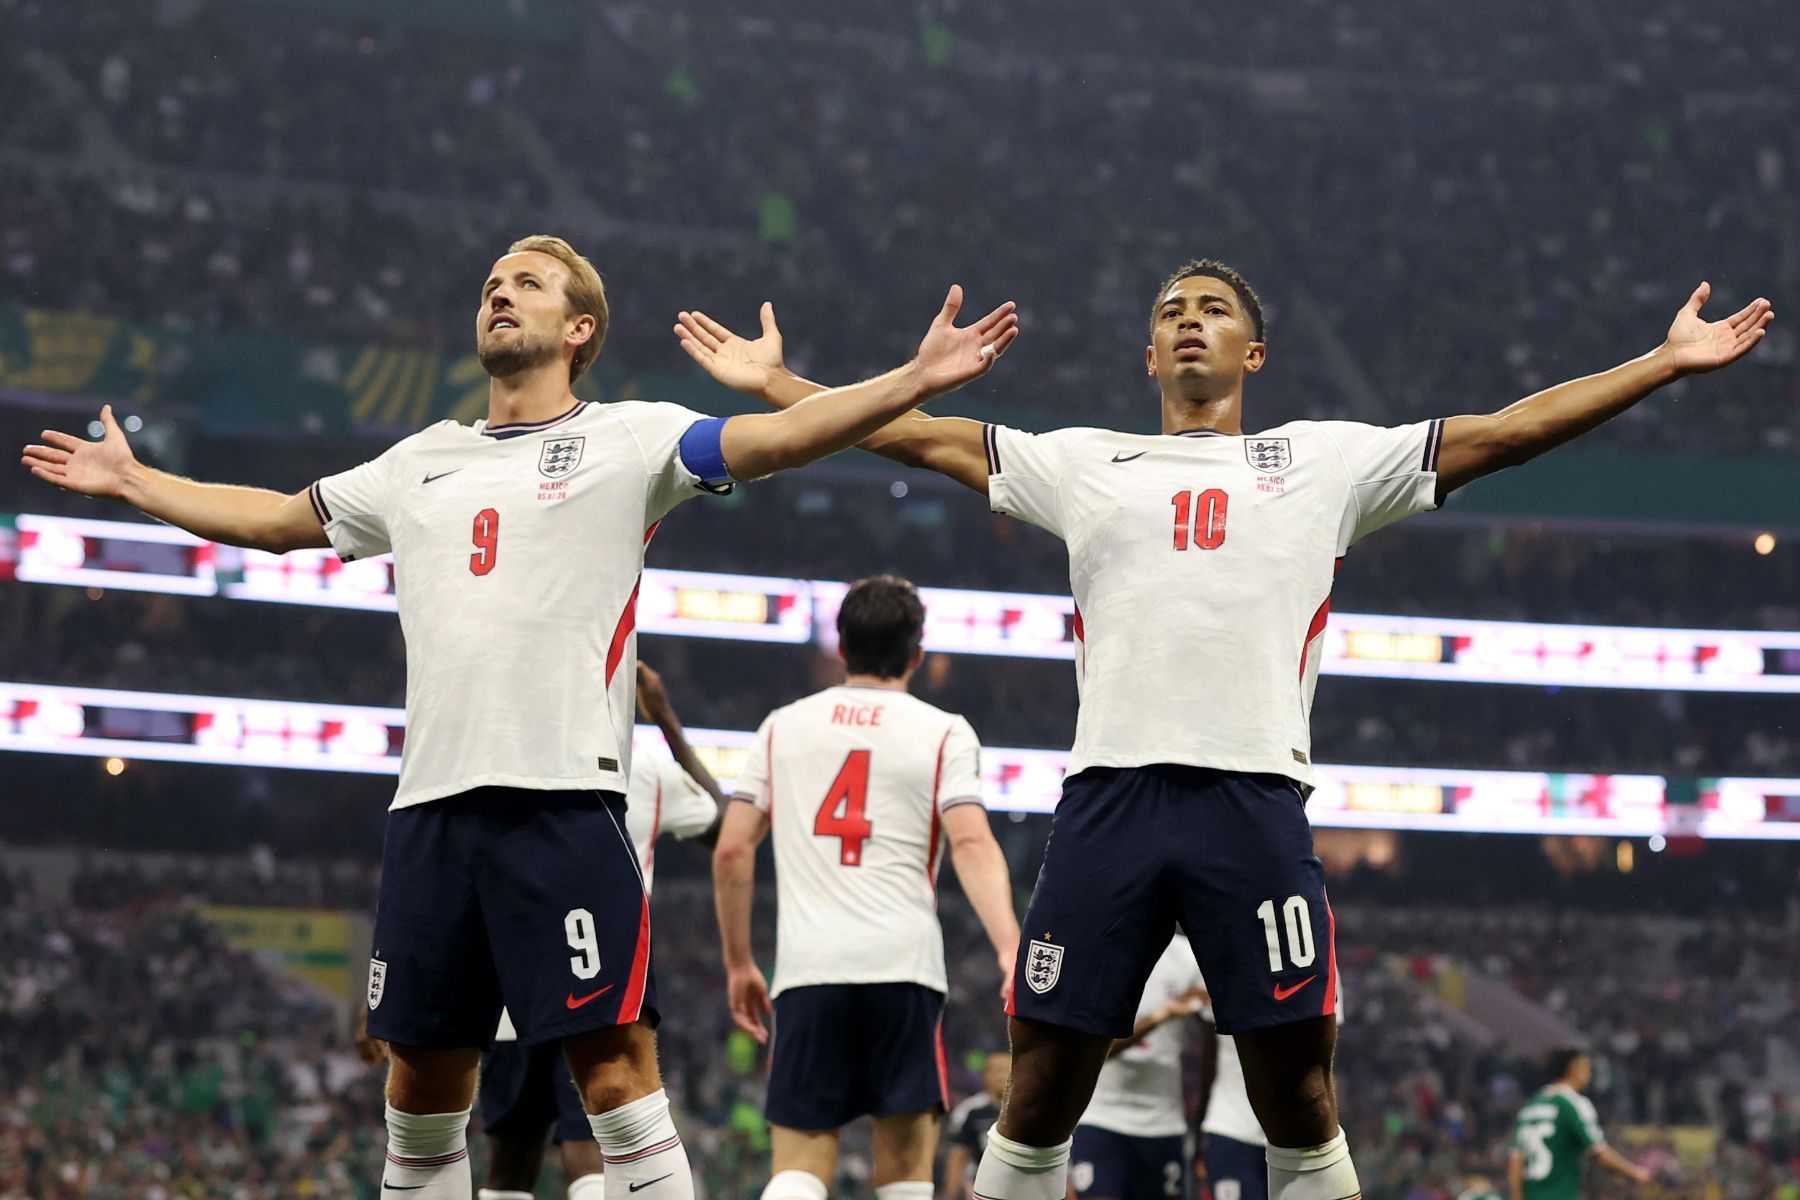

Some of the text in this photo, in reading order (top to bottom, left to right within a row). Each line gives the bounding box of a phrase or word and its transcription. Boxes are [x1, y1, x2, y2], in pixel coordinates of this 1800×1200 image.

[539, 482, 568, 490] MEXICO
[1171, 488, 1229, 551] 10
[469, 508, 499, 576] 9
[832, 703, 885, 727] RICE
[814, 750, 873, 866] 4
[564, 908, 601, 980] 9
[1257, 895, 1316, 972] 10
